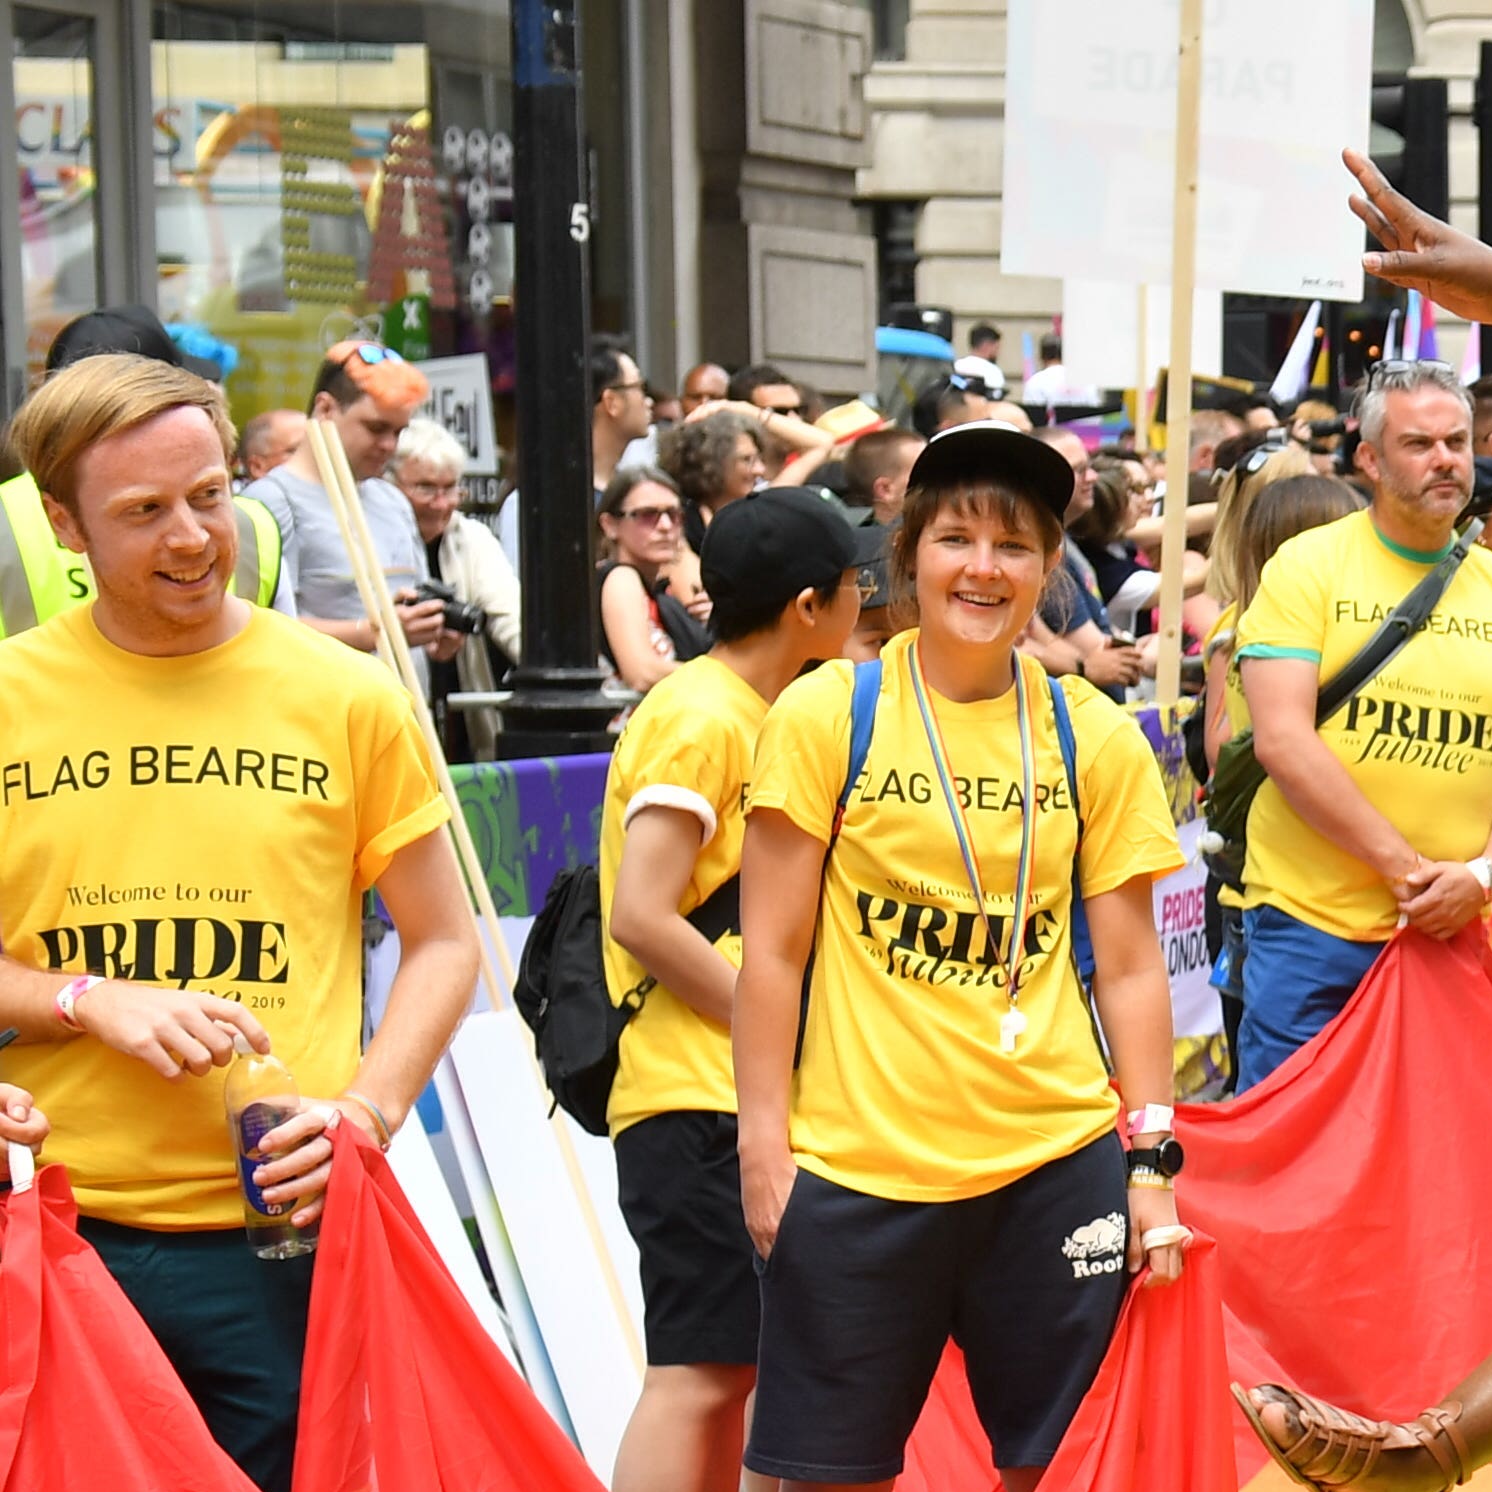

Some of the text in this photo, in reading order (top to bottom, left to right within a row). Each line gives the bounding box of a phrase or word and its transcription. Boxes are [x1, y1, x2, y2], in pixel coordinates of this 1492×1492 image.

[570, 203, 590, 241] 5
[1336, 600, 1395, 624] FLA
[1374, 675, 1483, 704] Welcome to our
[1353, 729, 1474, 774] Jubilee
[3, 745, 330, 806] FLAG BEARER
[66, 882, 253, 907] Welcome to our
[1161, 885, 1205, 936] PRIDE
[36, 917, 290, 990] PRIDE
[1161, 929, 1207, 978] ONDO
[251, 995, 286, 1009] 2019
